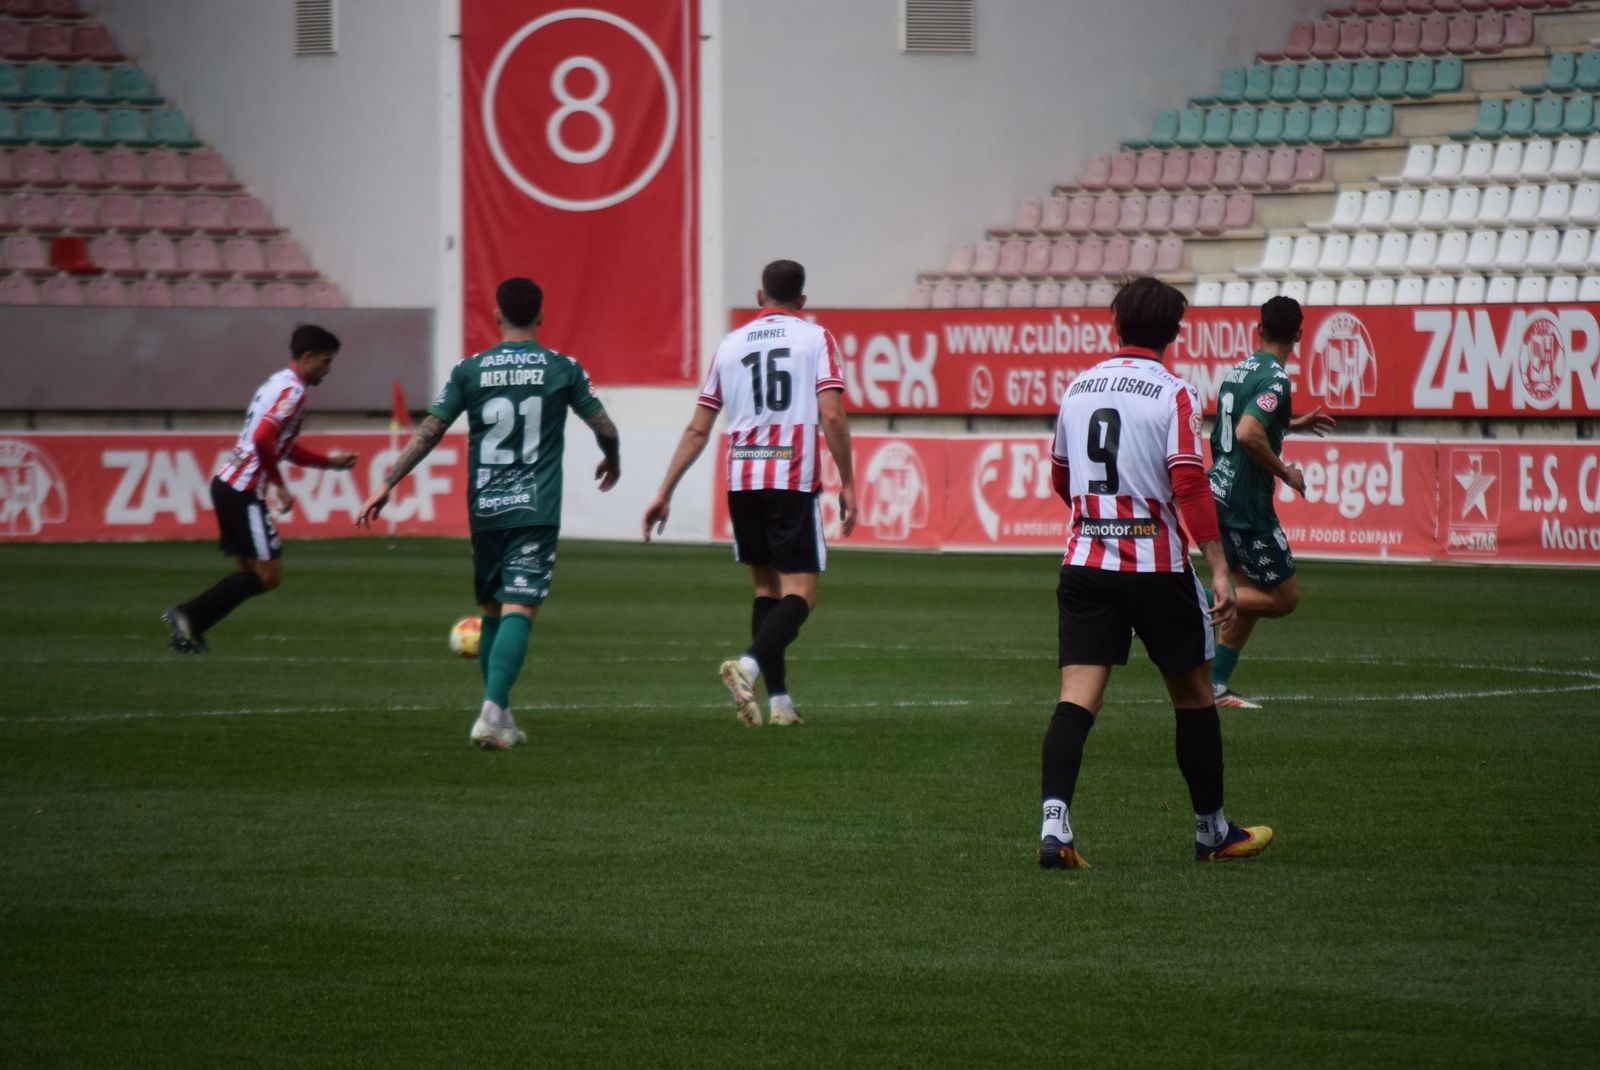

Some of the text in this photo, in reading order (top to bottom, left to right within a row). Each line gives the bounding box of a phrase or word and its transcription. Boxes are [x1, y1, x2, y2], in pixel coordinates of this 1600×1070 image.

[547, 55, 615, 165] 8
[747, 328, 787, 342] MARKEL
[1174, 320, 1261, 359] FUNDAC
[479, 352, 548, 368] ABANCA
[480, 370, 508, 388] ALEX
[841, 331, 939, 409] iex
[740, 347, 792, 416] 16
[1006, 368, 1048, 407] 675
[1068, 376, 1109, 399] MARIO
[1111, 376, 1164, 400] LOSADA
[479, 396, 543, 465] 21
[733, 448, 793, 459] leomotor.net
[1086, 407, 1122, 496] 9
[1519, 452, 1568, 514] E.S.
[1283, 528, 1404, 546] LIFE FOODS COMPANY
